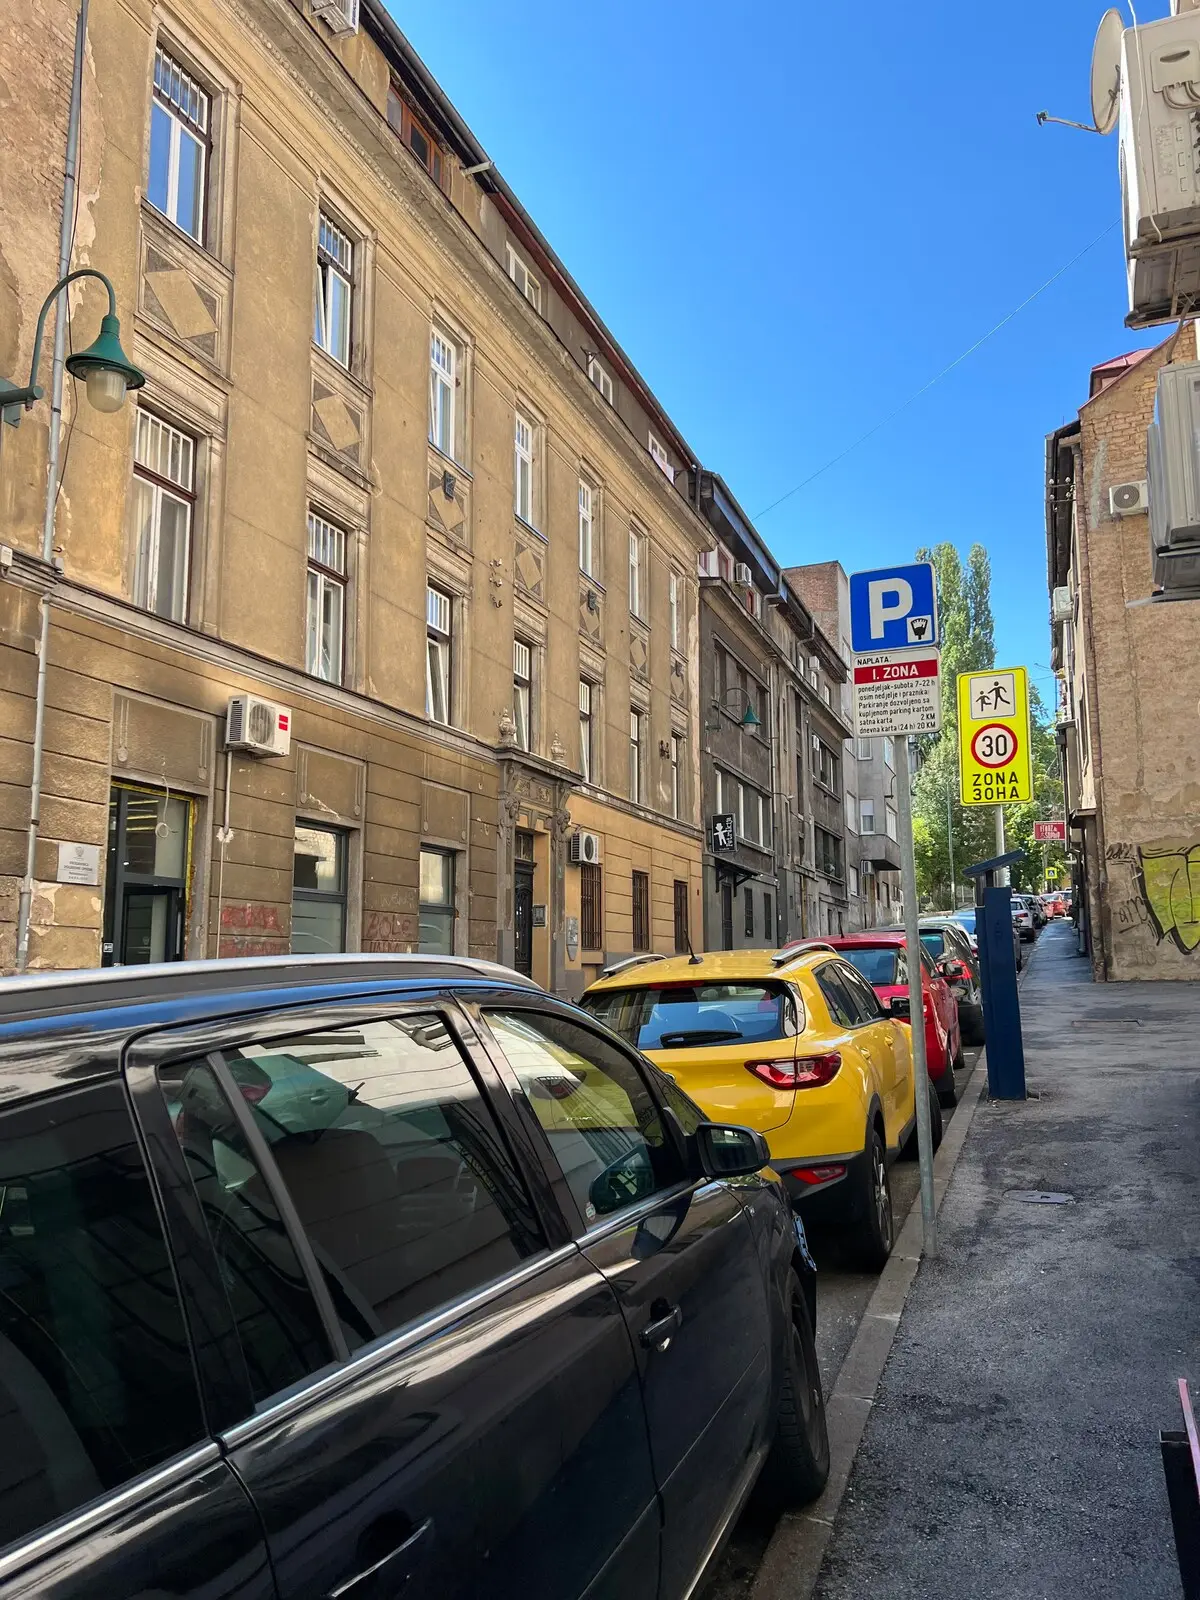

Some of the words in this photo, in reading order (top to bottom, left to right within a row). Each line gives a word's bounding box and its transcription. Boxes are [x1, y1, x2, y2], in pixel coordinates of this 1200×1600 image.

[868, 577, 913, 639] P
[872, 668, 880, 680] I.
[883, 664, 919, 679] ZONA
[858, 681, 914, 694] ponedjeljak-subota
[915, 679, 930, 688] 7-22
[875, 691, 898, 700] nedjelje
[858, 700, 888, 710] Parkiranje
[889, 698, 922, 707] dozvoljeno
[859, 709, 888, 718] kupljenom
[889, 707, 911, 716] parking
[912, 704, 934, 713] kartom
[925, 712, 936, 720] KM
[859, 726, 880, 734] dnevna
[881, 724, 897, 732] karta
[917, 722, 926, 730] 20
[926, 721, 936, 729] KM
[981, 734, 1008, 757] 30
[972, 771, 1019, 787] ZONA
[973, 786, 1020, 801] ЗОНА
